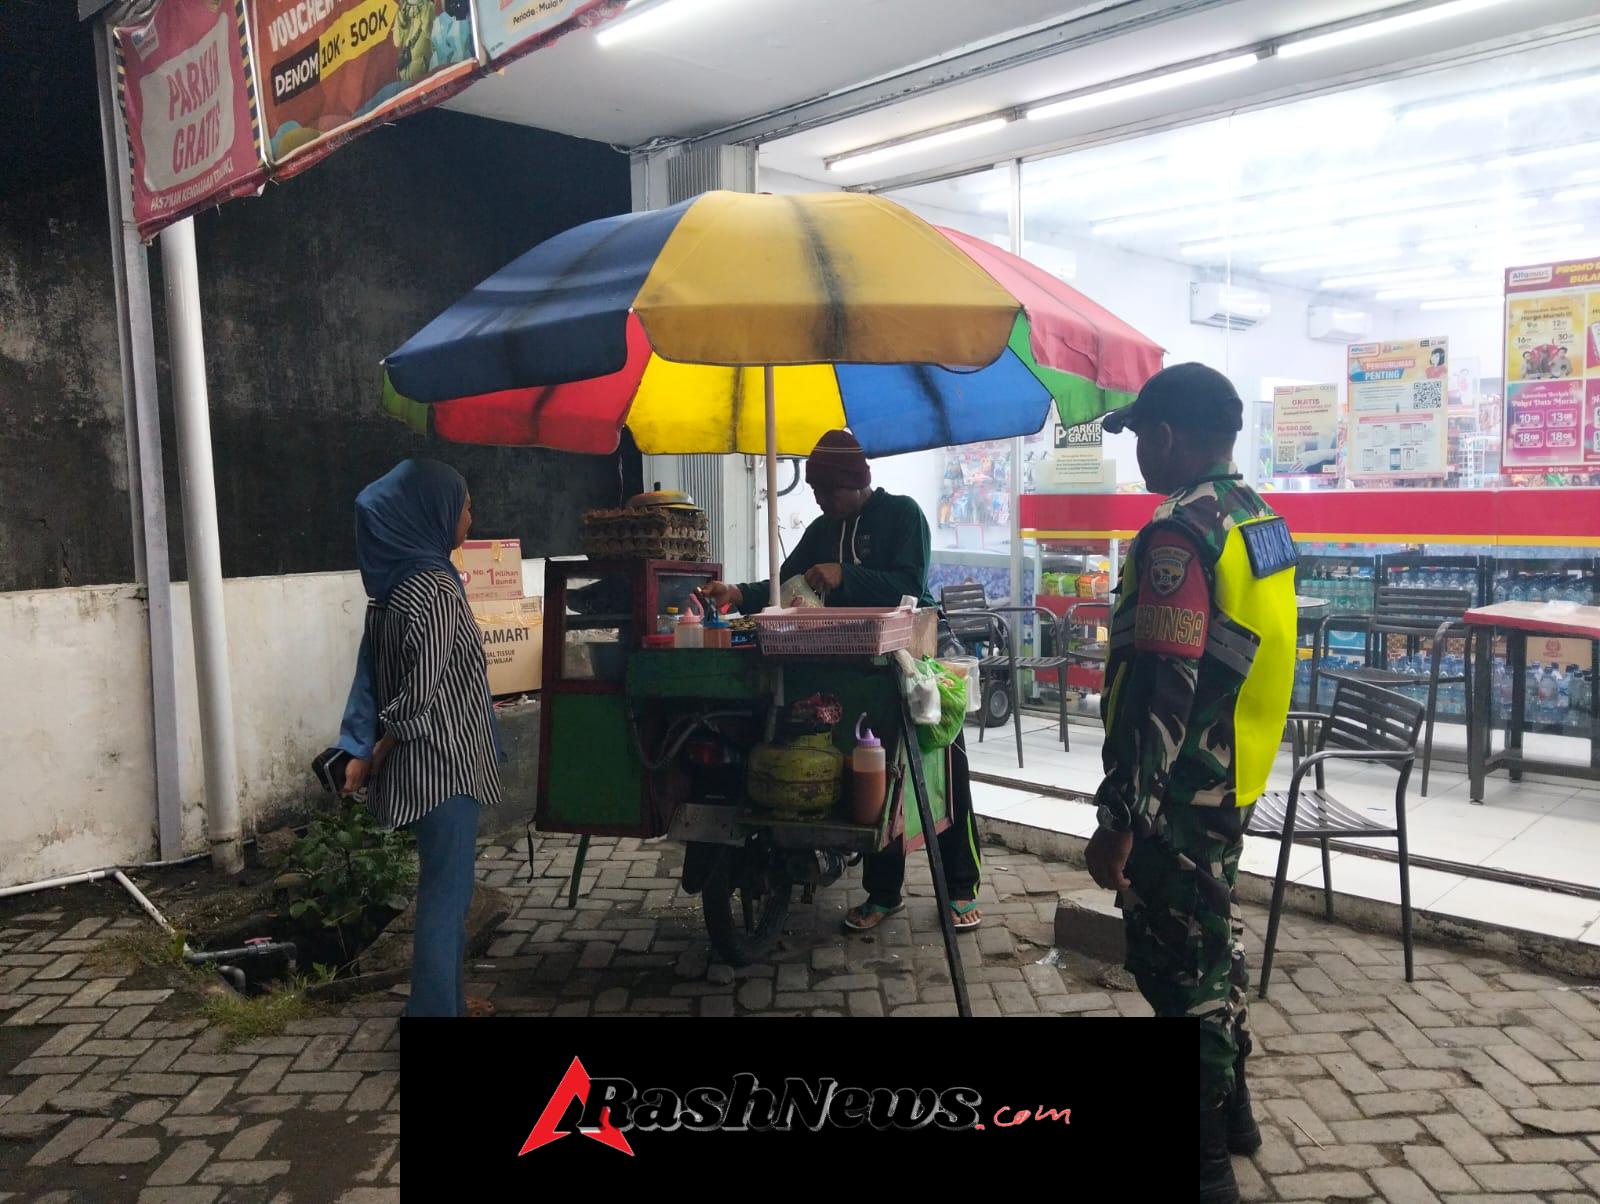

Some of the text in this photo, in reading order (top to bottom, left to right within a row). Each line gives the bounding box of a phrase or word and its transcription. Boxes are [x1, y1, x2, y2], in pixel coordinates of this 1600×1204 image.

[275, 52, 319, 97] DENOM
[321, 33, 341, 69] 10K
[350, 4, 388, 47] 500K
[166, 40, 220, 121] PARKIR
[172, 99, 220, 174] GRATIS
[1364, 371, 1400, 380] PENTING
[1292, 398, 1320, 406] GRATIS
[1069, 433, 1101, 442] GRATIS
[486, 568, 495, 585] 1
[480, 627, 530, 645] AMART
[496, 649, 515, 657] TISSUE
